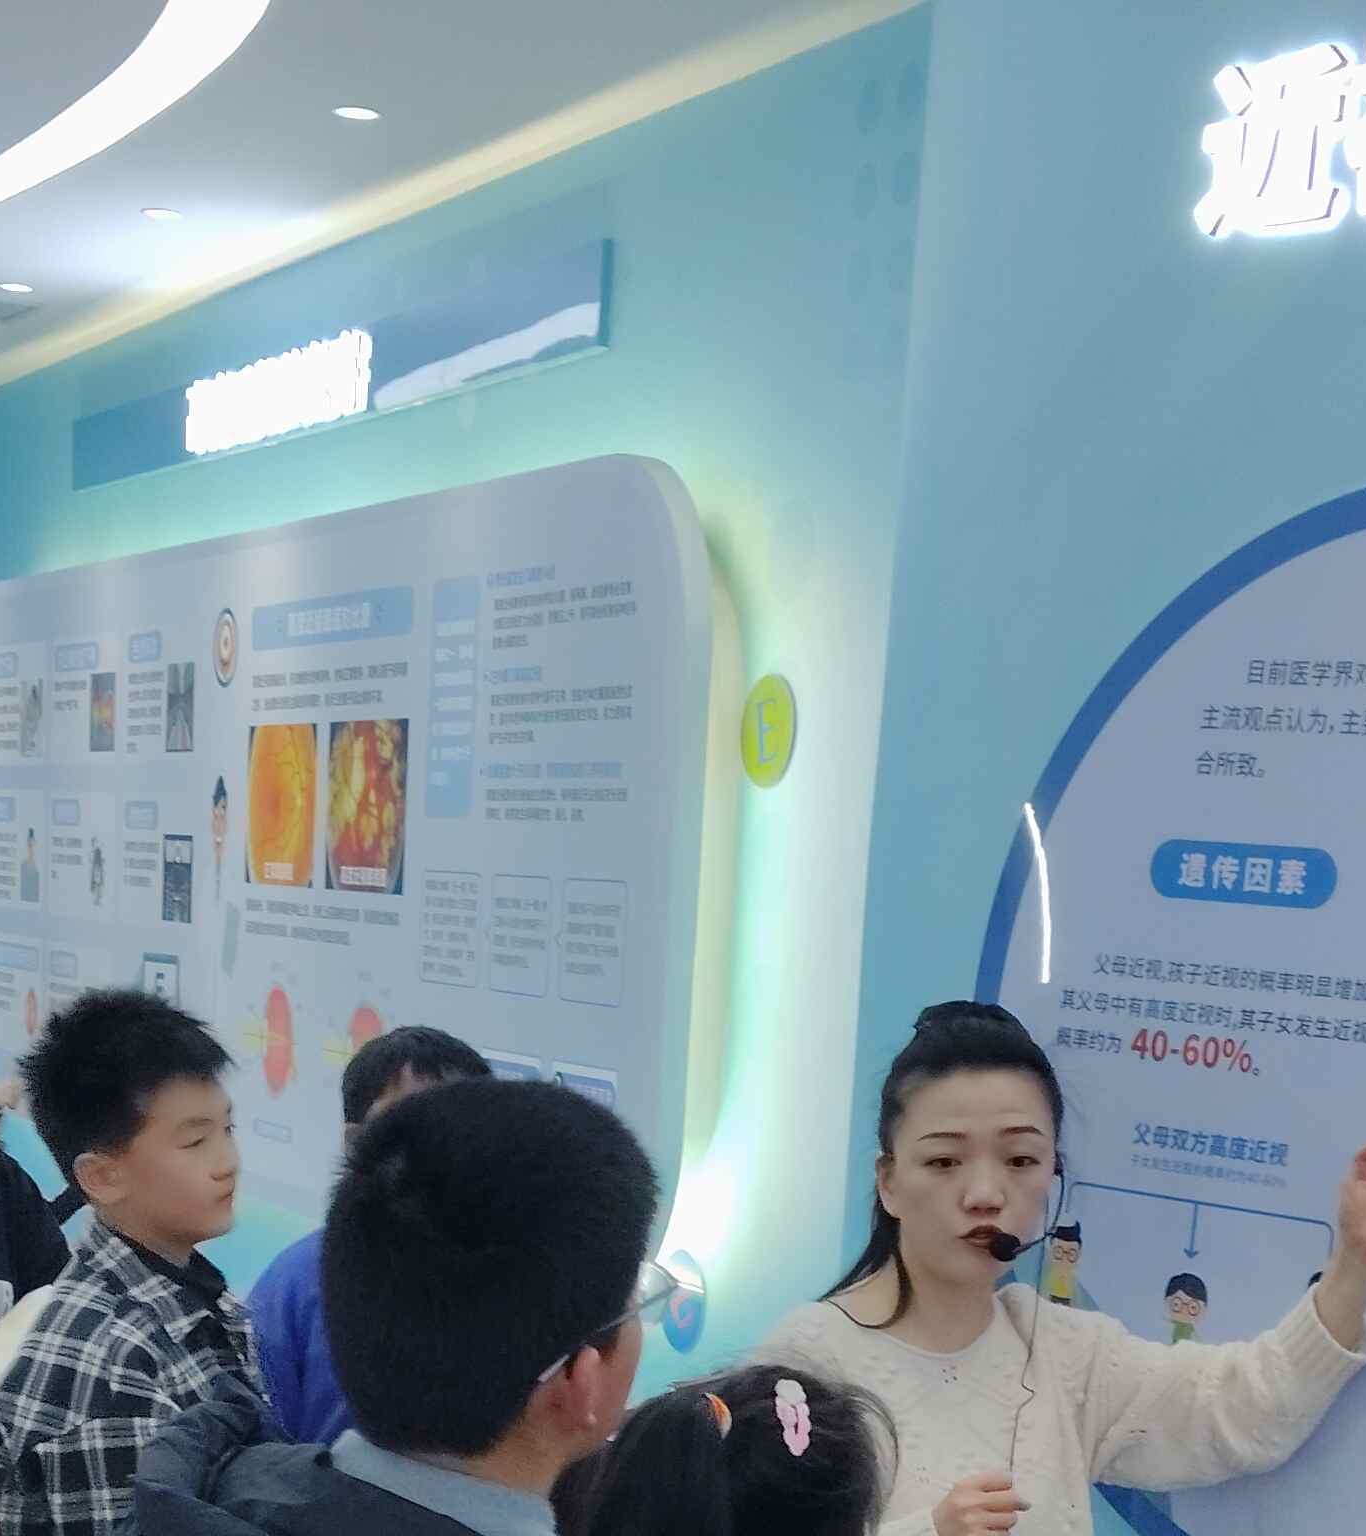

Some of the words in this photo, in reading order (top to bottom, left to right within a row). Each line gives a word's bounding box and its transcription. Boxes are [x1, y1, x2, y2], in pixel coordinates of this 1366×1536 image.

[1196, 752, 1266, 780] 合所致。
[1178, 852, 1307, 896] 遗传因素
[1056, 1026, 1123, 1054] 概率约为
[1132, 1121, 1289, 1168] 父母双方高度近视
